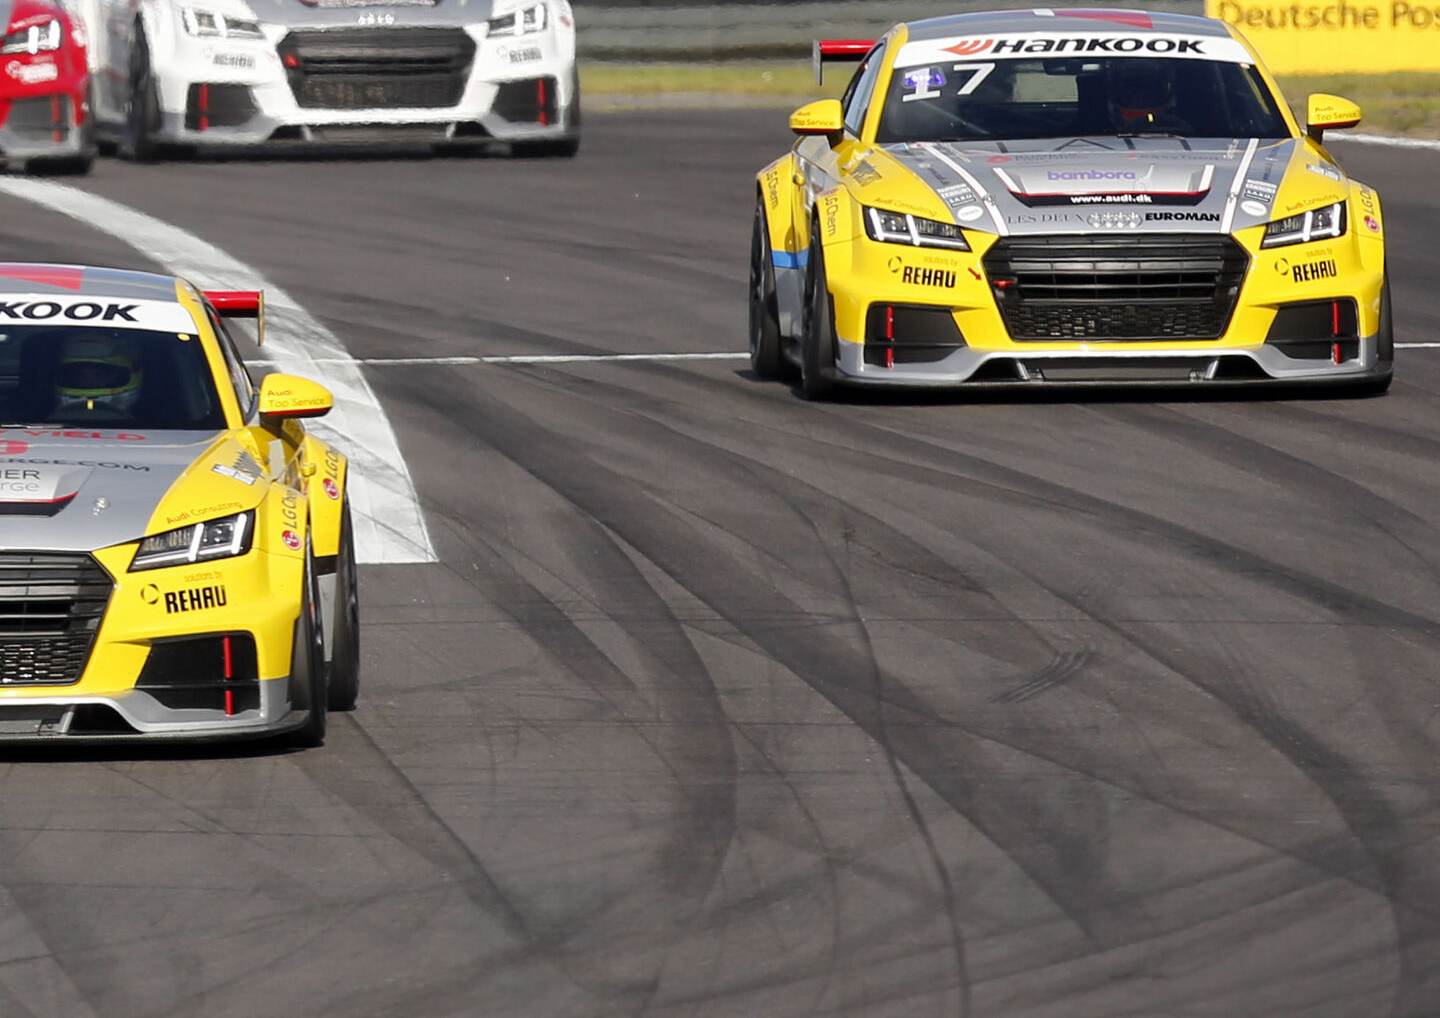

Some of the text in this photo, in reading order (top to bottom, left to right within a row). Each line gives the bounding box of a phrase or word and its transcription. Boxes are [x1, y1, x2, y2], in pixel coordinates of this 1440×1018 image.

[902, 62, 997, 103] 17
[1047, 169, 1137, 182] bambora
[1070, 193, 1153, 204] www.audi.dk
[1007, 214, 1038, 224] LES
[1144, 212, 1221, 223] EUROMAN
[902, 265, 957, 289] REHAU
[1292, 259, 1338, 283] REHAU
[267, 388, 294, 397] Audi
[268, 397, 326, 408] Top Service
[24, 429, 148, 441] YIELD
[166, 501, 243, 525] Audi Consulting
[164, 584, 228, 615] REHAU
